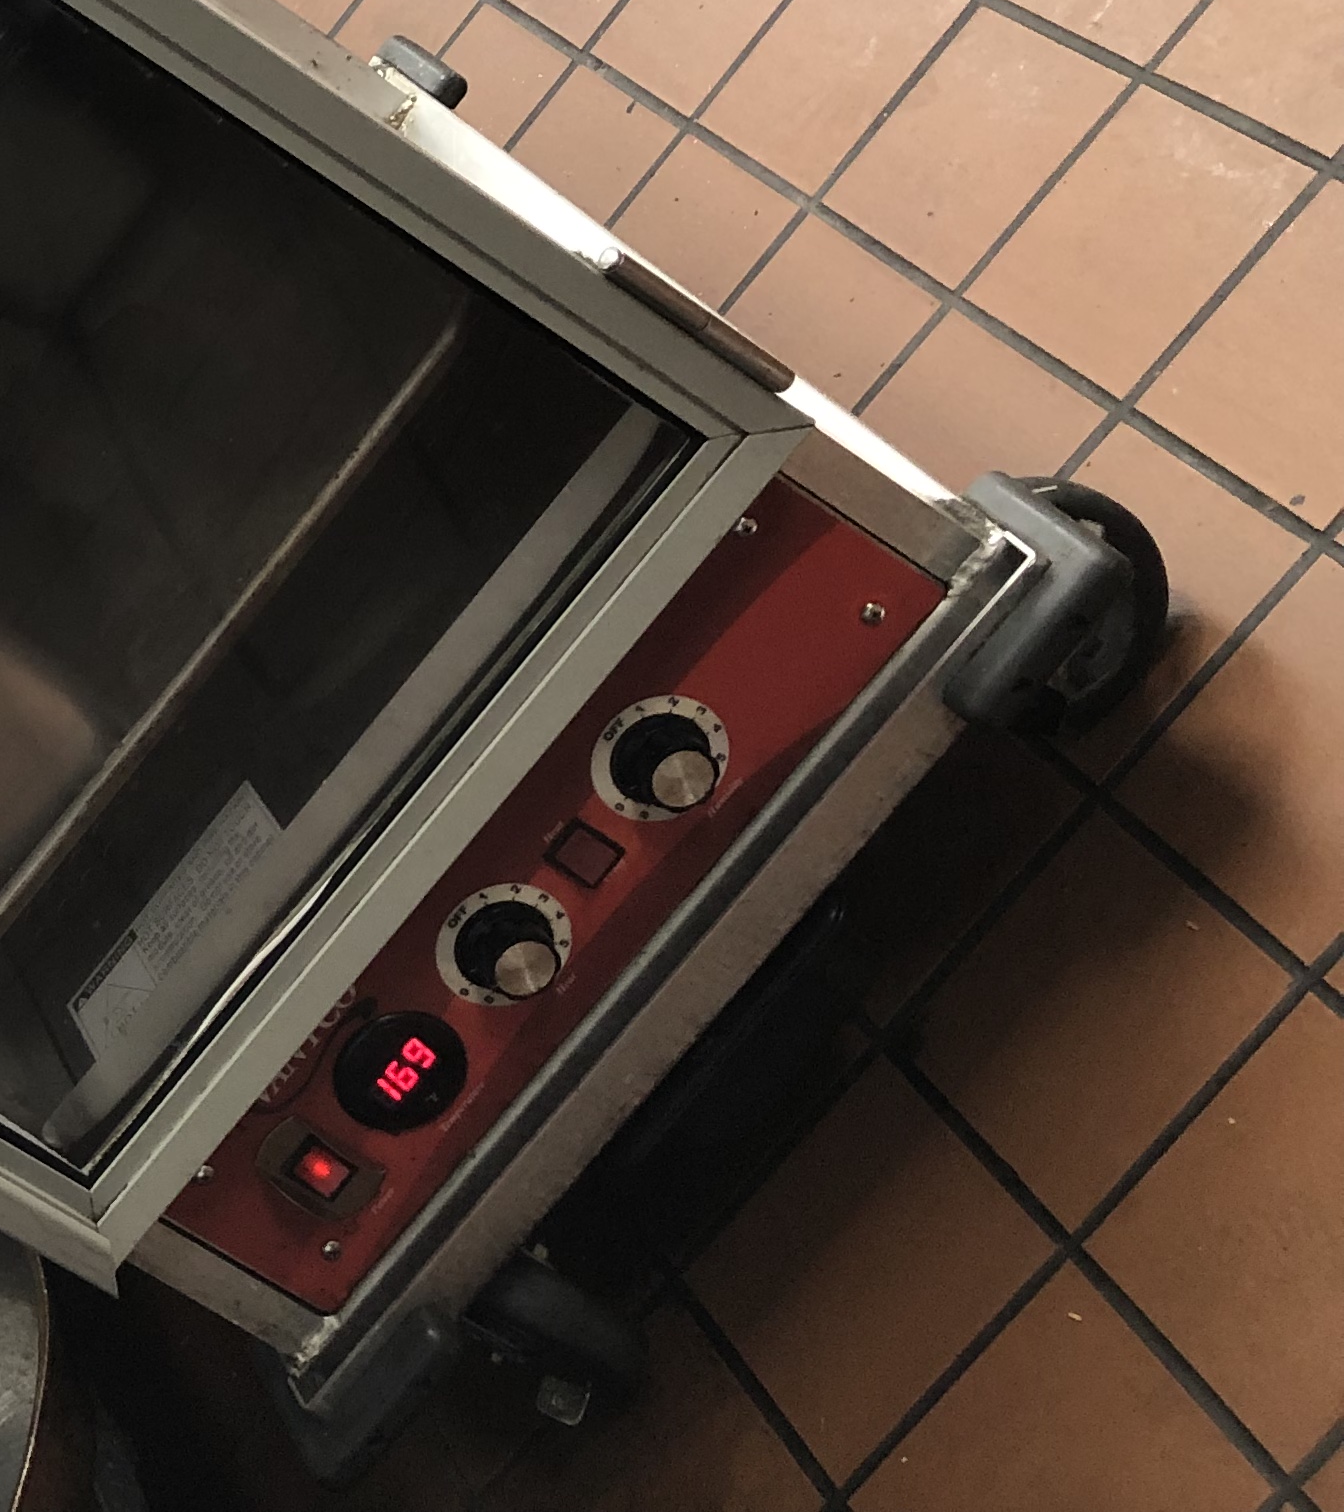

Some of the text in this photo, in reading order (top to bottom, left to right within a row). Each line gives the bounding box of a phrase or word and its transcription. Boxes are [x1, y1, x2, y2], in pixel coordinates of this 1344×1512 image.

[603, 718, 622, 741] OFF
[447, 905, 466, 928] OFF
[373, 1033, 439, 1104] 169
